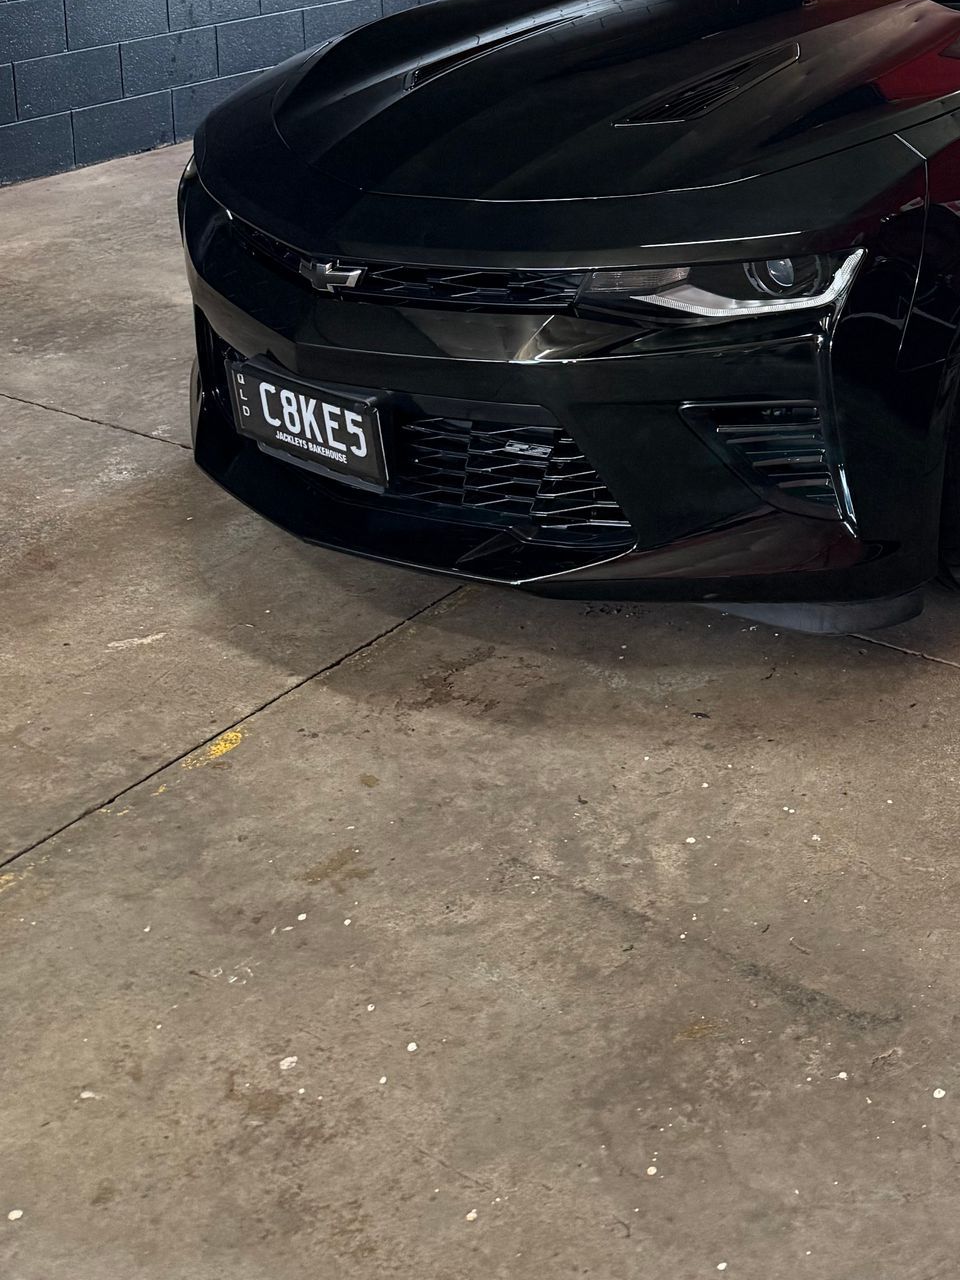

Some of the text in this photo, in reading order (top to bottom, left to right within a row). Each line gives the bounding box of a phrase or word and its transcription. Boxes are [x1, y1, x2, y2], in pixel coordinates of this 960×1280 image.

[237, 373, 250, 416] QLD
[259, 381, 368, 458] C8KE5
[275, 430, 348, 464] JACKLEYS BAKEHOUSE
